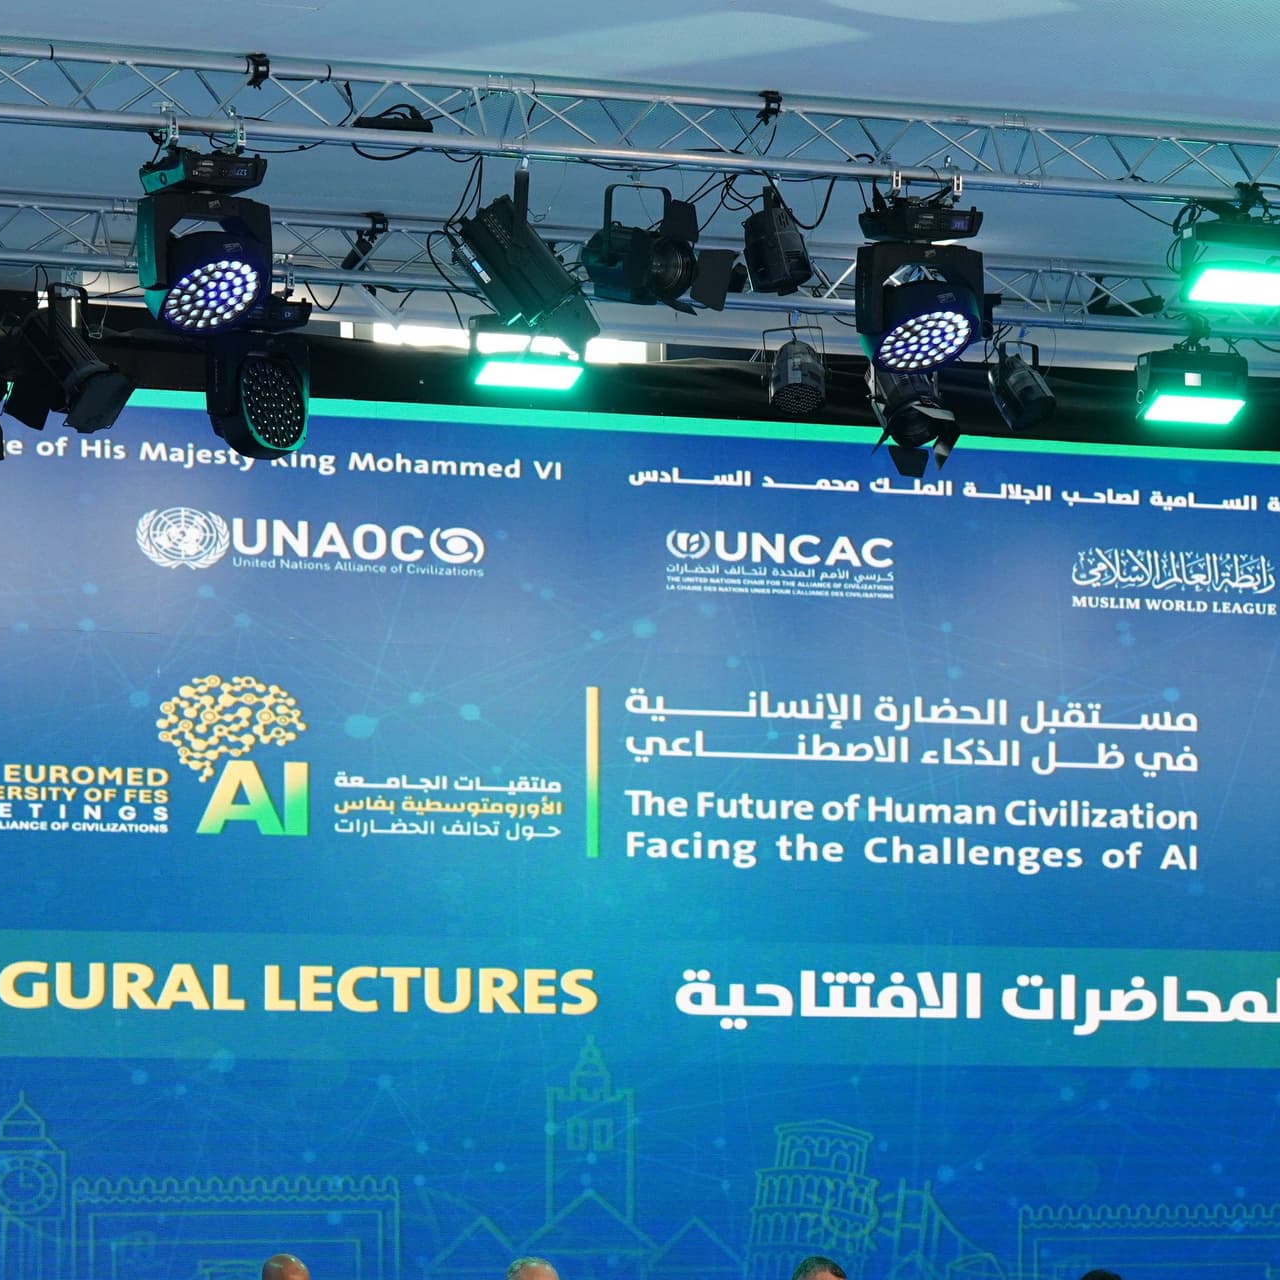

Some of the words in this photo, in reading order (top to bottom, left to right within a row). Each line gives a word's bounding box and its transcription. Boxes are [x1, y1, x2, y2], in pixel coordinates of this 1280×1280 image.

[36, 437, 69, 457] of
[80, 438, 126, 460] His
[139, 443, 256, 471] Majesty
[348, 452, 521, 479] Mohammed
[534, 460, 563, 481] VI
[628, 467, 752, 488] السادس
[762, 476, 860, 493] محمد
[869, 476, 953, 497] الملك
[963, 481, 1052, 505] الجلالة
[1061, 488, 1140, 508] لصاحب
[1150, 490, 1257, 511] السامية
[232, 517, 424, 564] UNAOC
[714, 530, 894, 569] UNCAC
[232, 556, 276, 570] United
[280, 558, 331, 572] Nations
[334, 560, 388, 575] Alliance
[391, 562, 404, 575] of
[406, 563, 485, 577] Civilizations
[1072, 595, 1141, 611] MUSLIM
[1145, 598, 1207, 613] WORLD
[1213, 601, 1277, 616] LEAGUE
[624, 686, 861, 730] الإنسانية
[873, 696, 1008, 731] الحضارة
[1020, 700, 1198, 735] مستقبل
[624, 729, 909, 765] الاصطناعي
[920, 740, 1020, 767] الذكاء
[1031, 741, 1124, 774] ظل
[2, 764, 169, 788] EUROMED
[1135, 750, 1198, 778] في
[334, 770, 448, 794] الجامعة
[453, 770, 562, 796] ملتقيات
[87, 787, 117, 804] OF
[124, 787, 168, 805] FES
[196, 760, 309, 837] AI
[334, 794, 395, 817] بفاس
[624, 789, 689, 817] The
[696, 791, 816, 822] Future
[821, 793, 860, 822] of
[867, 796, 996, 826] Human
[1004, 799, 1198, 831] Civilization
[51, 821, 68, 832] OF
[71, 822, 169, 834] CIVILIZATIONS
[334, 816, 434, 839] الحضارات
[438, 818, 499, 837] تحالف
[505, 819, 561, 841] حول
[625, 831, 756, 869] Facing
[776, 834, 844, 863] the
[863, 836, 1083, 875] Challenges
[1101, 841, 1141, 870] of
[1160, 844, 1198, 871] AI
[265, 964, 598, 1016] LECTURES
[675, 968, 981, 1030] الافتتاحية
